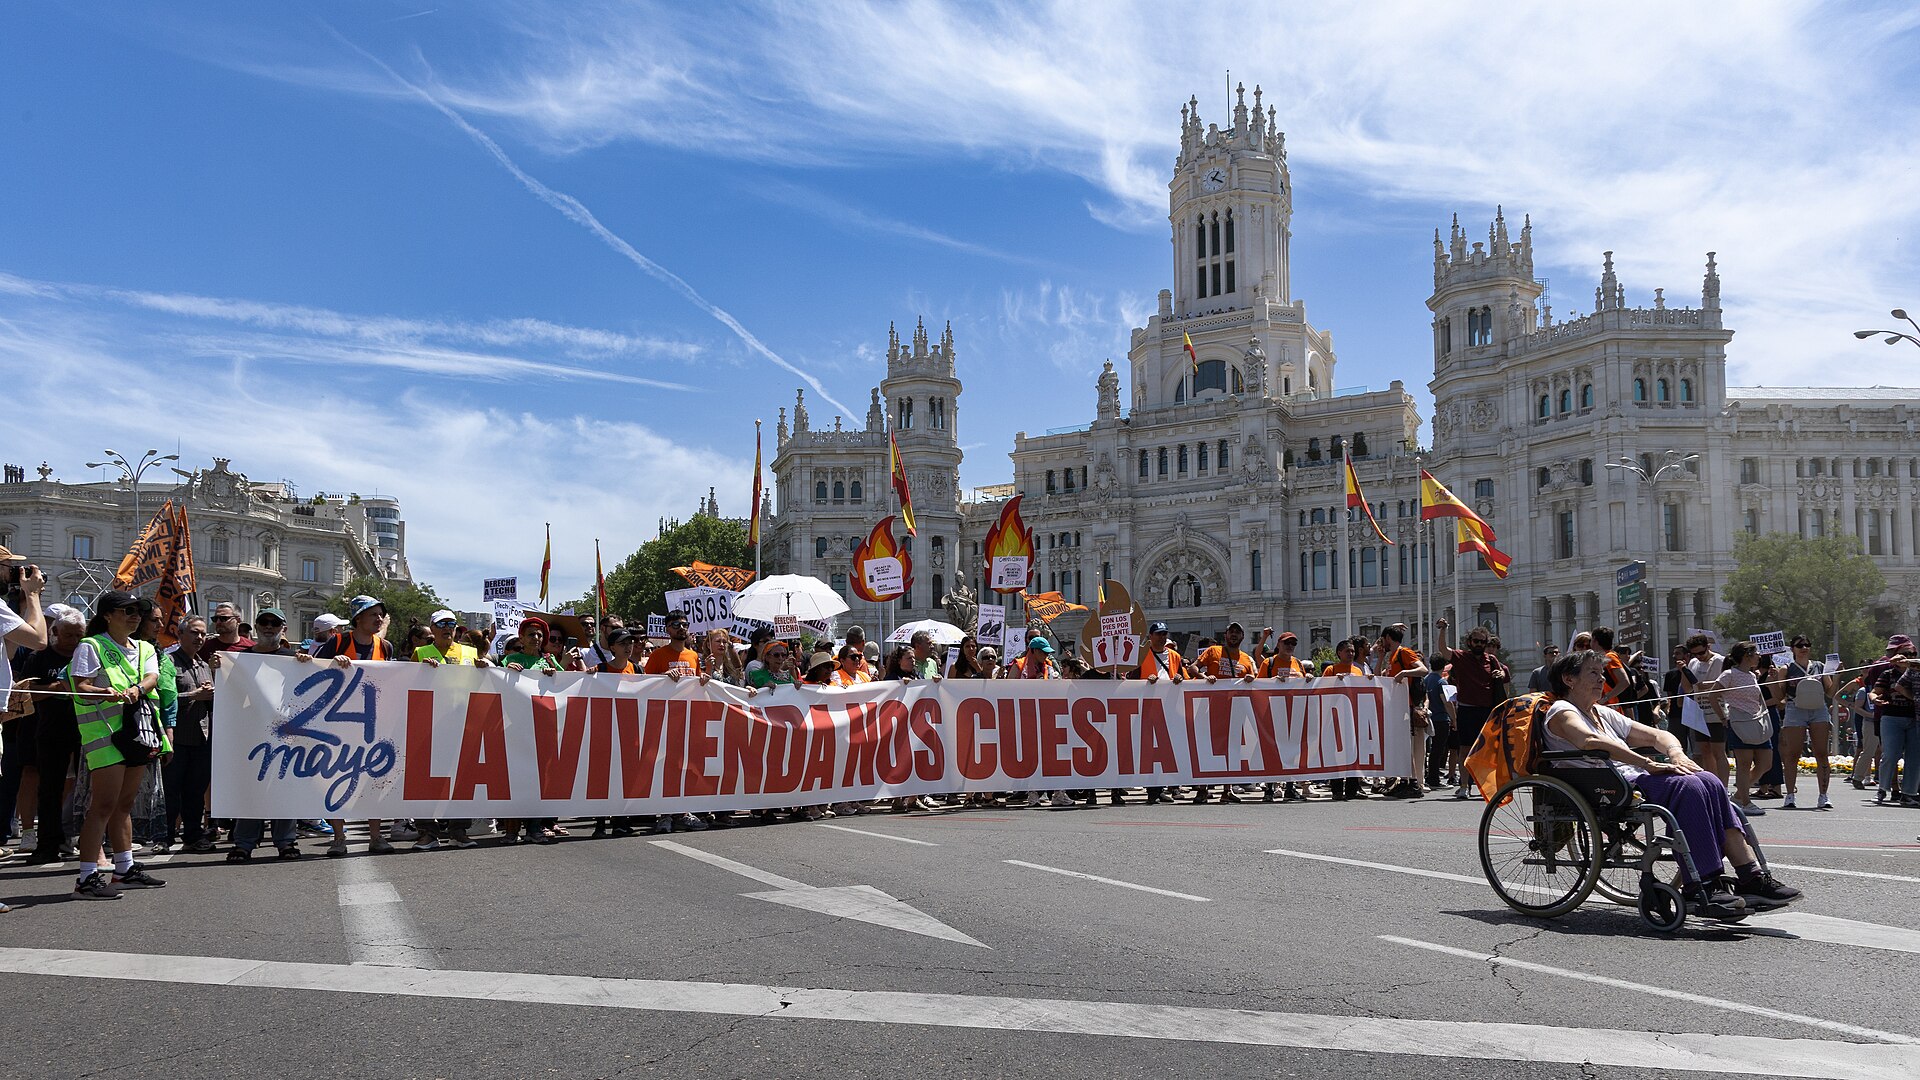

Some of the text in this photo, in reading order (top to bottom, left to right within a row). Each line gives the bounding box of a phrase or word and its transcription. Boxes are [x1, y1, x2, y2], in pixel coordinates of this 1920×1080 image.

[484, 578, 516, 588] DERECHO
[490, 586, 516, 595] TECHO
[650, 617, 666, 625] DERE
[774, 616, 797, 624] DERECHO
[779, 624, 798, 632] TECHO
[1751, 633, 1782, 643] DERECHO
[1757, 640, 1784, 650] TECHO
[276, 667, 377, 746] 24
[402, 689, 511, 801] LA
[531, 695, 836, 800] VIVIENDA
[842, 697, 945, 788] NOS
[956, 697, 1179, 781] CUESTA
[1191, 696, 1265, 772] LA
[1268, 692, 1383, 770] VIDA
[248, 740, 397, 812] mayo
